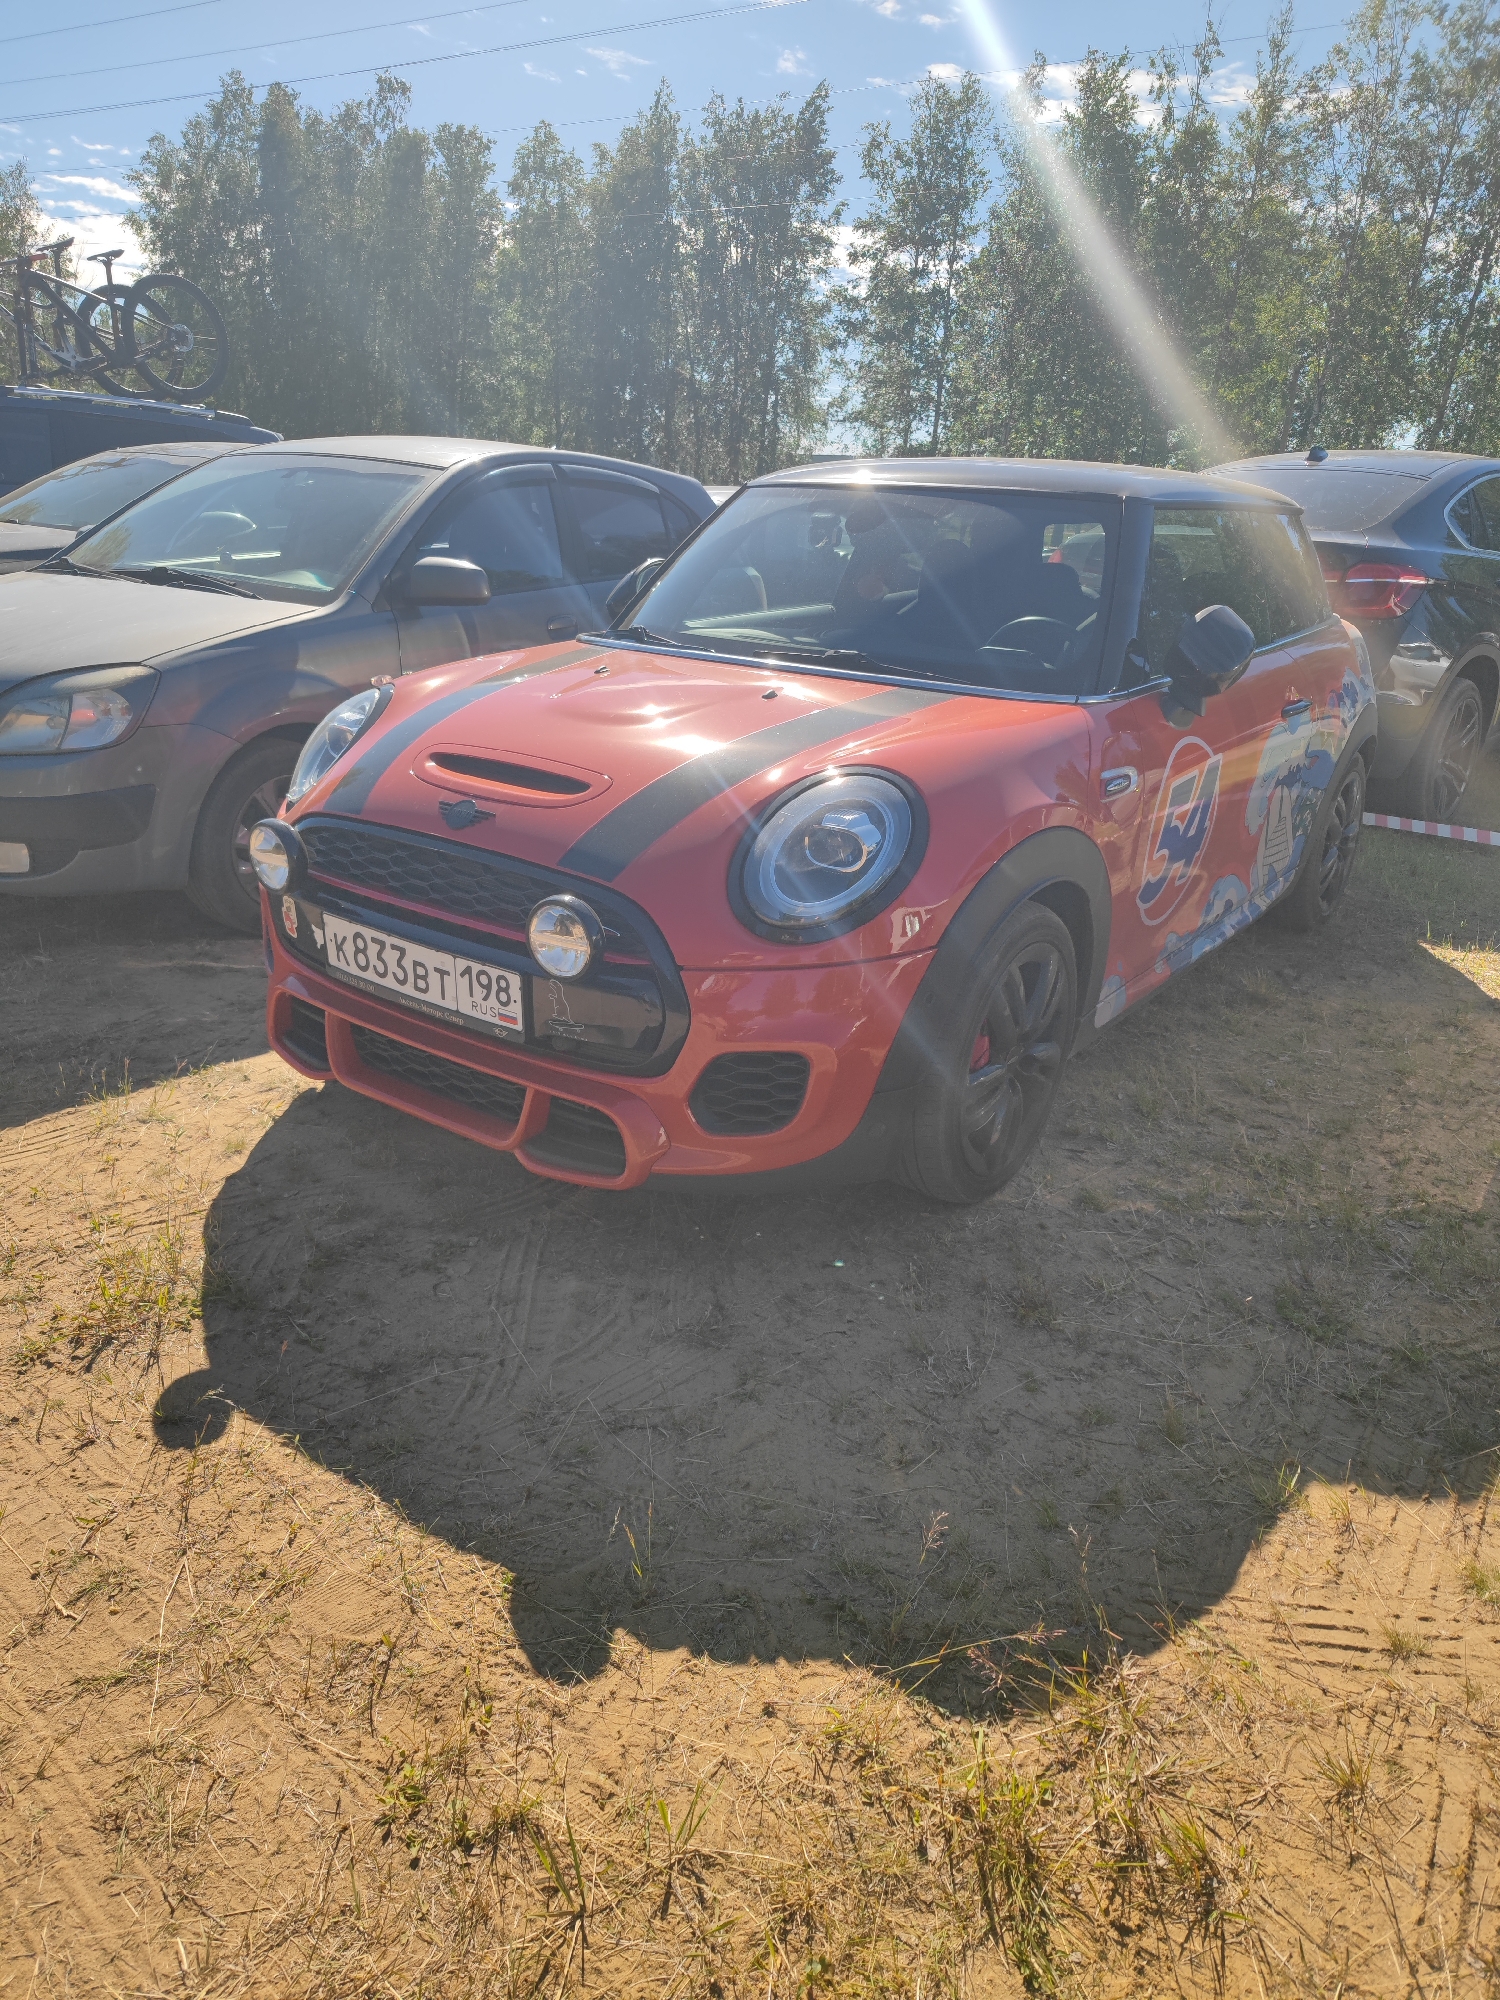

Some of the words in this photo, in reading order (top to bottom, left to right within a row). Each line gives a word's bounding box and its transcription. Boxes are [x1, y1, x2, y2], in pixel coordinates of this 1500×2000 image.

[1136, 753, 1223, 908] 54
[460, 965, 512, 1008] 198
[471, 1001, 497, 1018] RUS
